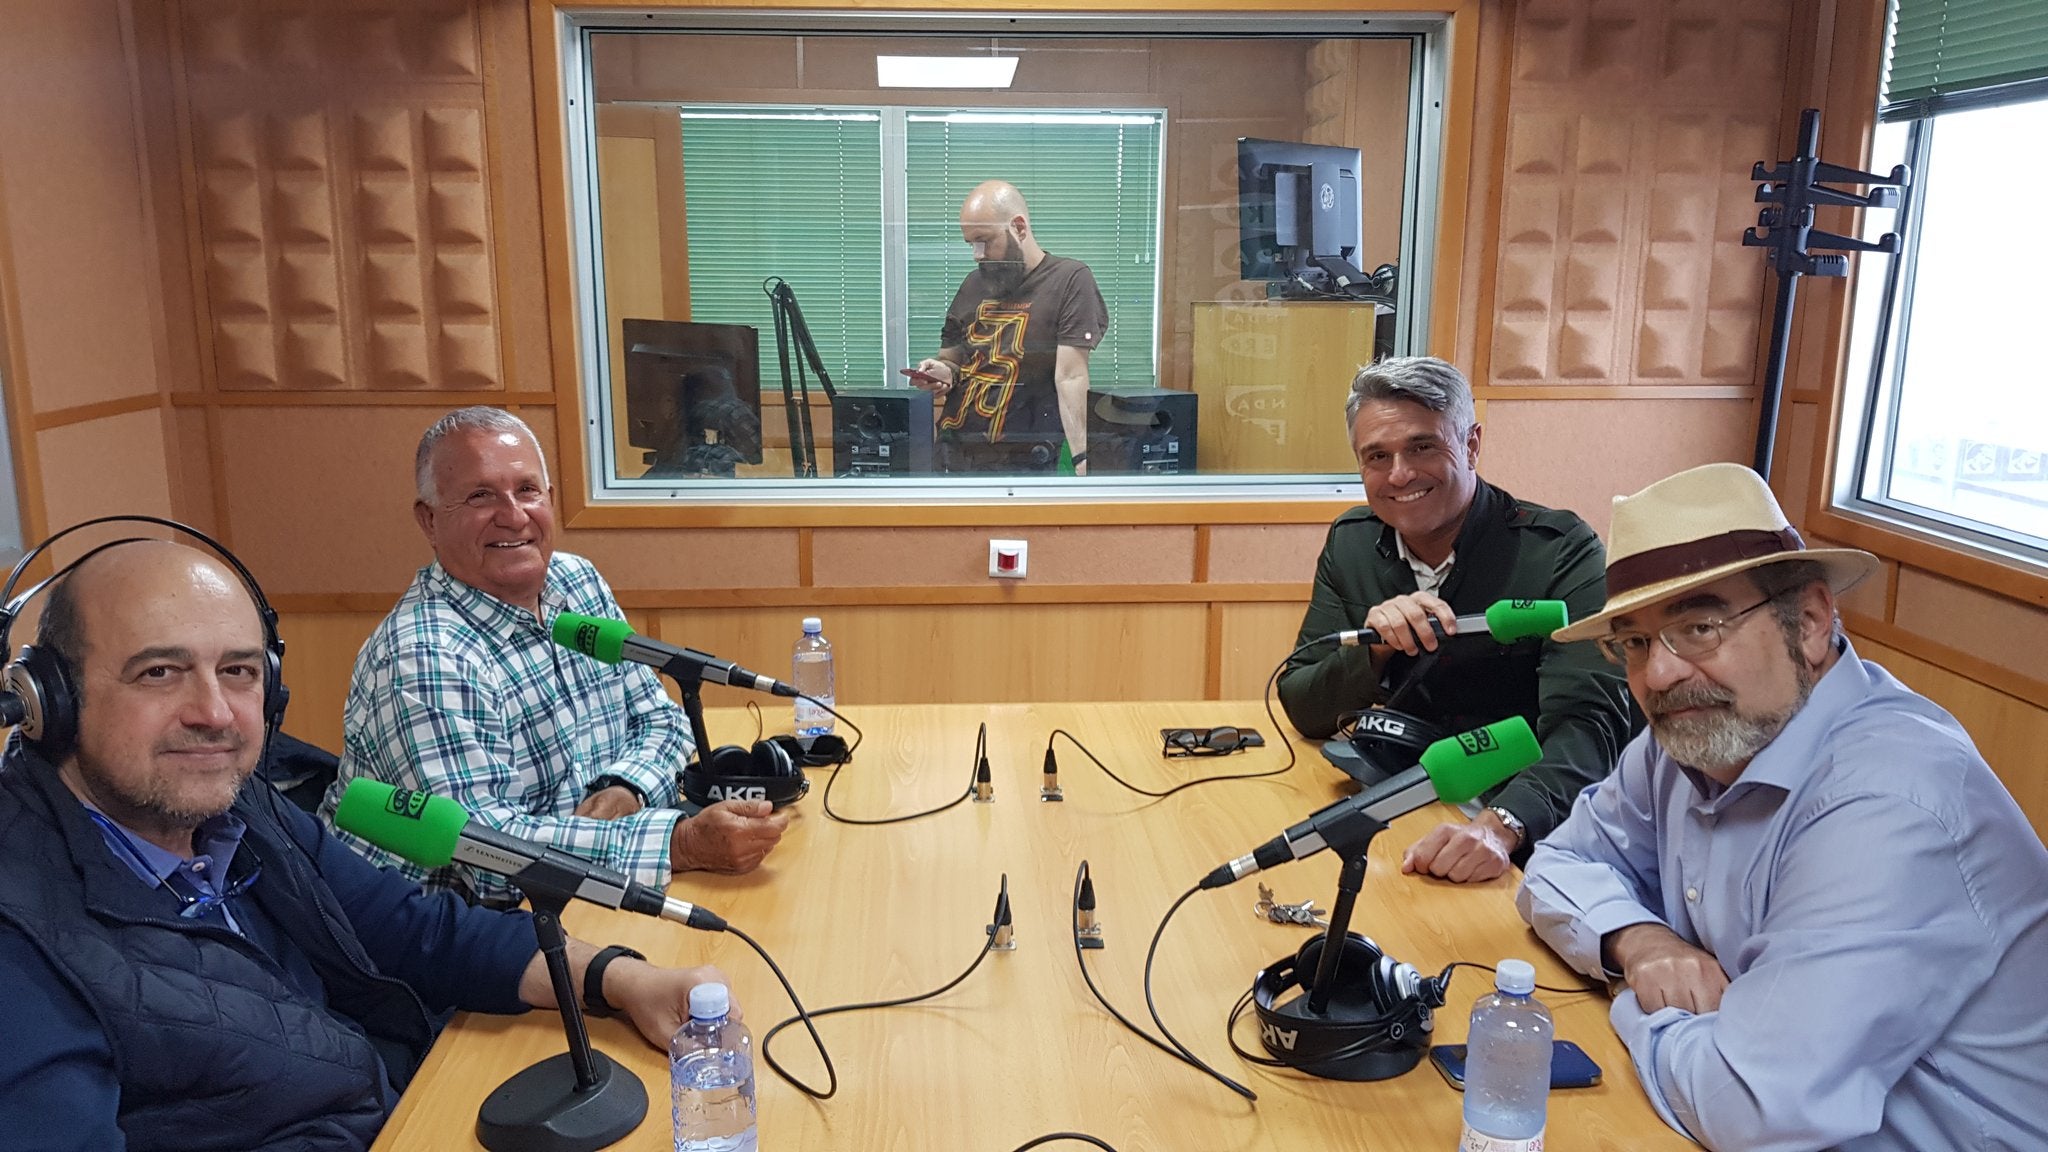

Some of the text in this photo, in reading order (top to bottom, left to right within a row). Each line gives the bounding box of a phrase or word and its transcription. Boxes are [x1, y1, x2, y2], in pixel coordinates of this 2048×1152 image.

[1356, 716, 1405, 736] AKG
[706, 785, 766, 802] AKG
[1259, 1019, 1298, 1051] AK
